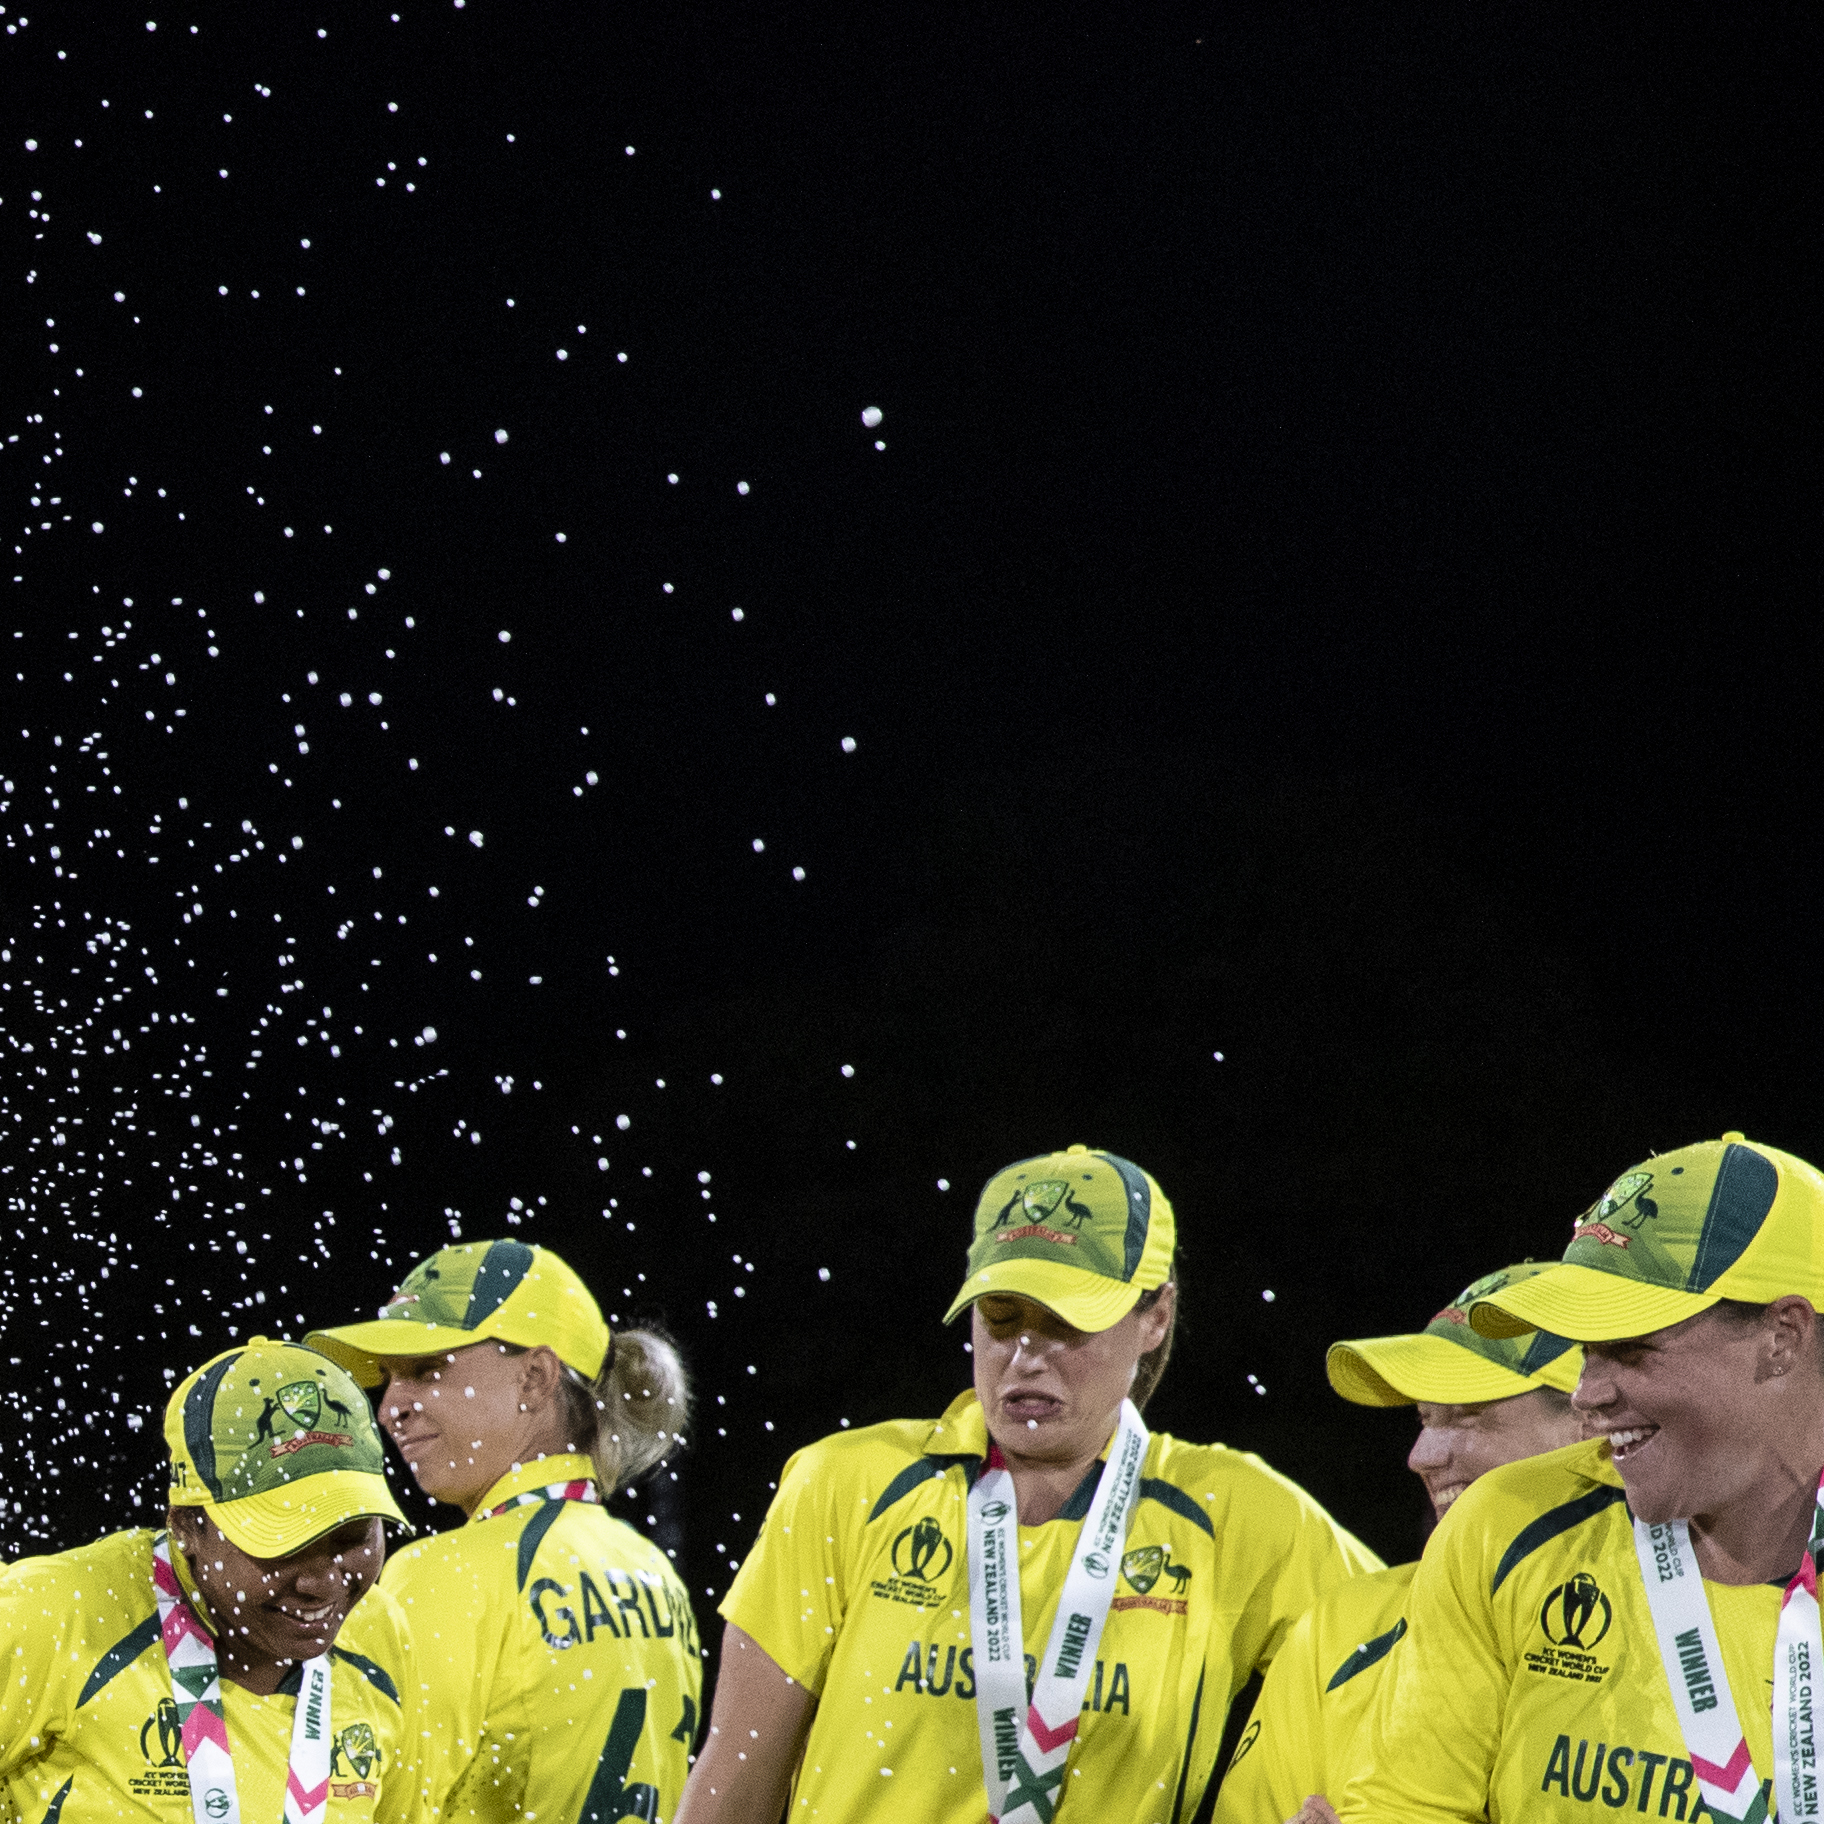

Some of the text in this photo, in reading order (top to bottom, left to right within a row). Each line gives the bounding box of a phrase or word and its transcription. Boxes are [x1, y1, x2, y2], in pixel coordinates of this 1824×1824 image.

[1653, 1540, 1674, 1584] 2022
[1673, 1555, 1686, 1578] CUP
[983, 1529, 1001, 1662] NEW ZEALAND 2022
[1053, 1612, 1093, 1679] WINNER
[1523, 1652, 1611, 1675] CRICKET WORLD CUP
[1541, 1646, 1598, 1666] ICC WOMEN'S
[1527, 1662, 1547, 1674] NEW
[1547, 1666, 1585, 1682] ZEALAND
[1674, 1626, 1719, 1715] WINNER
[1789, 1666, 1798, 1704] WORLD
[304, 1667, 326, 1741] WINNER
[992, 1707, 1018, 1782] WINNER
[1788, 1706, 1798, 1749] CRICKET
[1797, 1640, 1819, 1816] NEW ZEALAND 2022
[128, 1778, 191, 1788] CRICKET WORL
[133, 1787, 152, 1796] NEW
[159, 1771, 190, 1780] WOMEN
